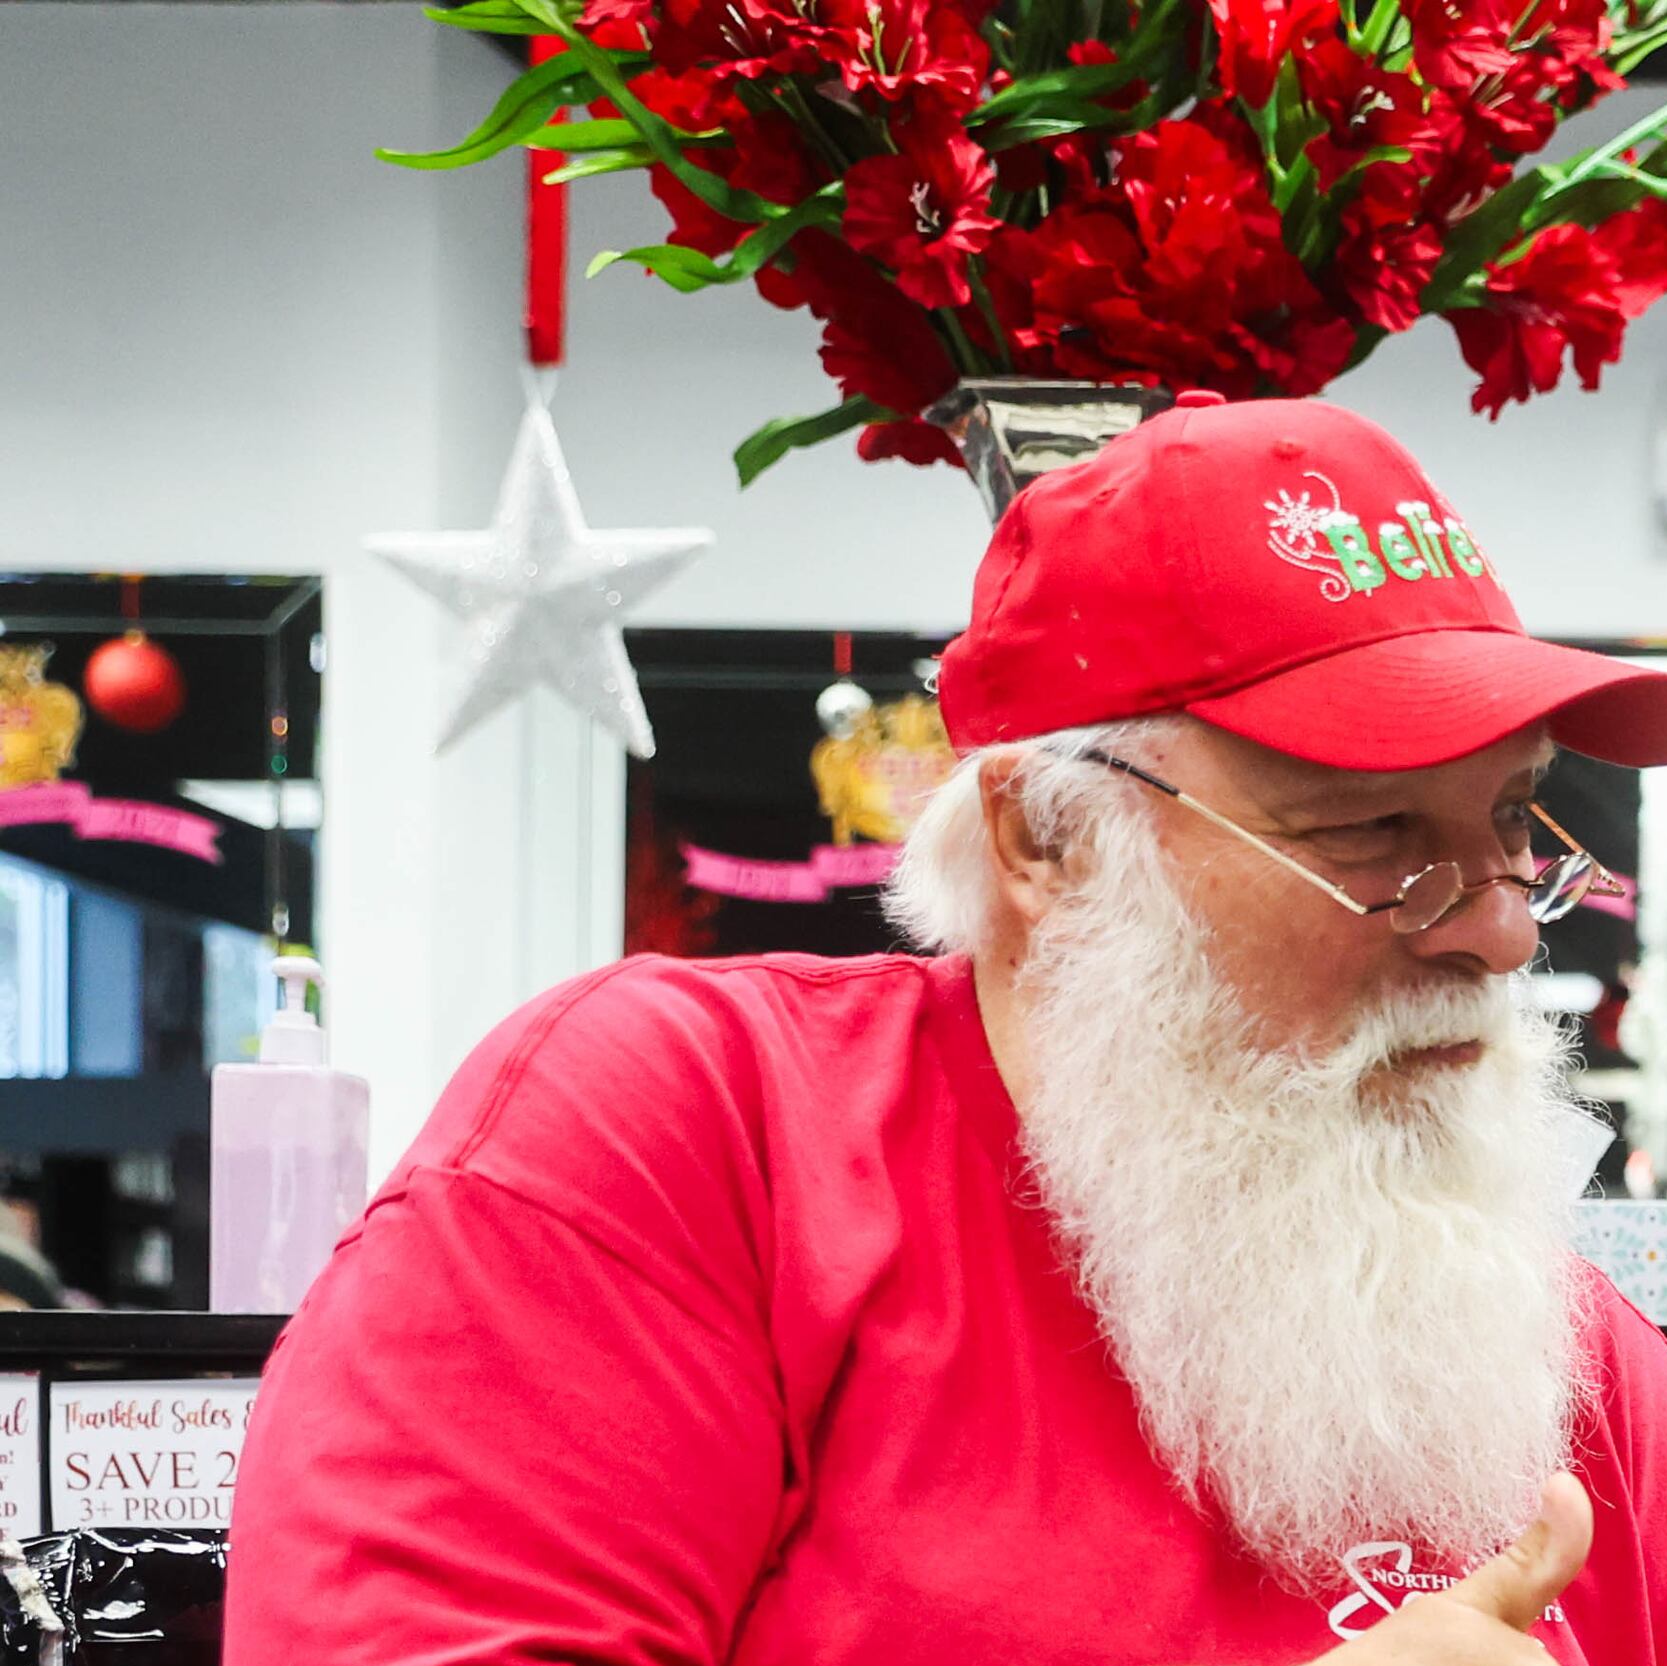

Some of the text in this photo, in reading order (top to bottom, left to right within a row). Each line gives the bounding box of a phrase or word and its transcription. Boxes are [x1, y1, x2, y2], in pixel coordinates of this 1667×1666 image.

[61, 1399, 162, 1433] Thankful
[171, 1399, 232, 1434] Sales
[66, 1451, 199, 1490] SAVE
[80, 1497, 114, 1522] 3+
